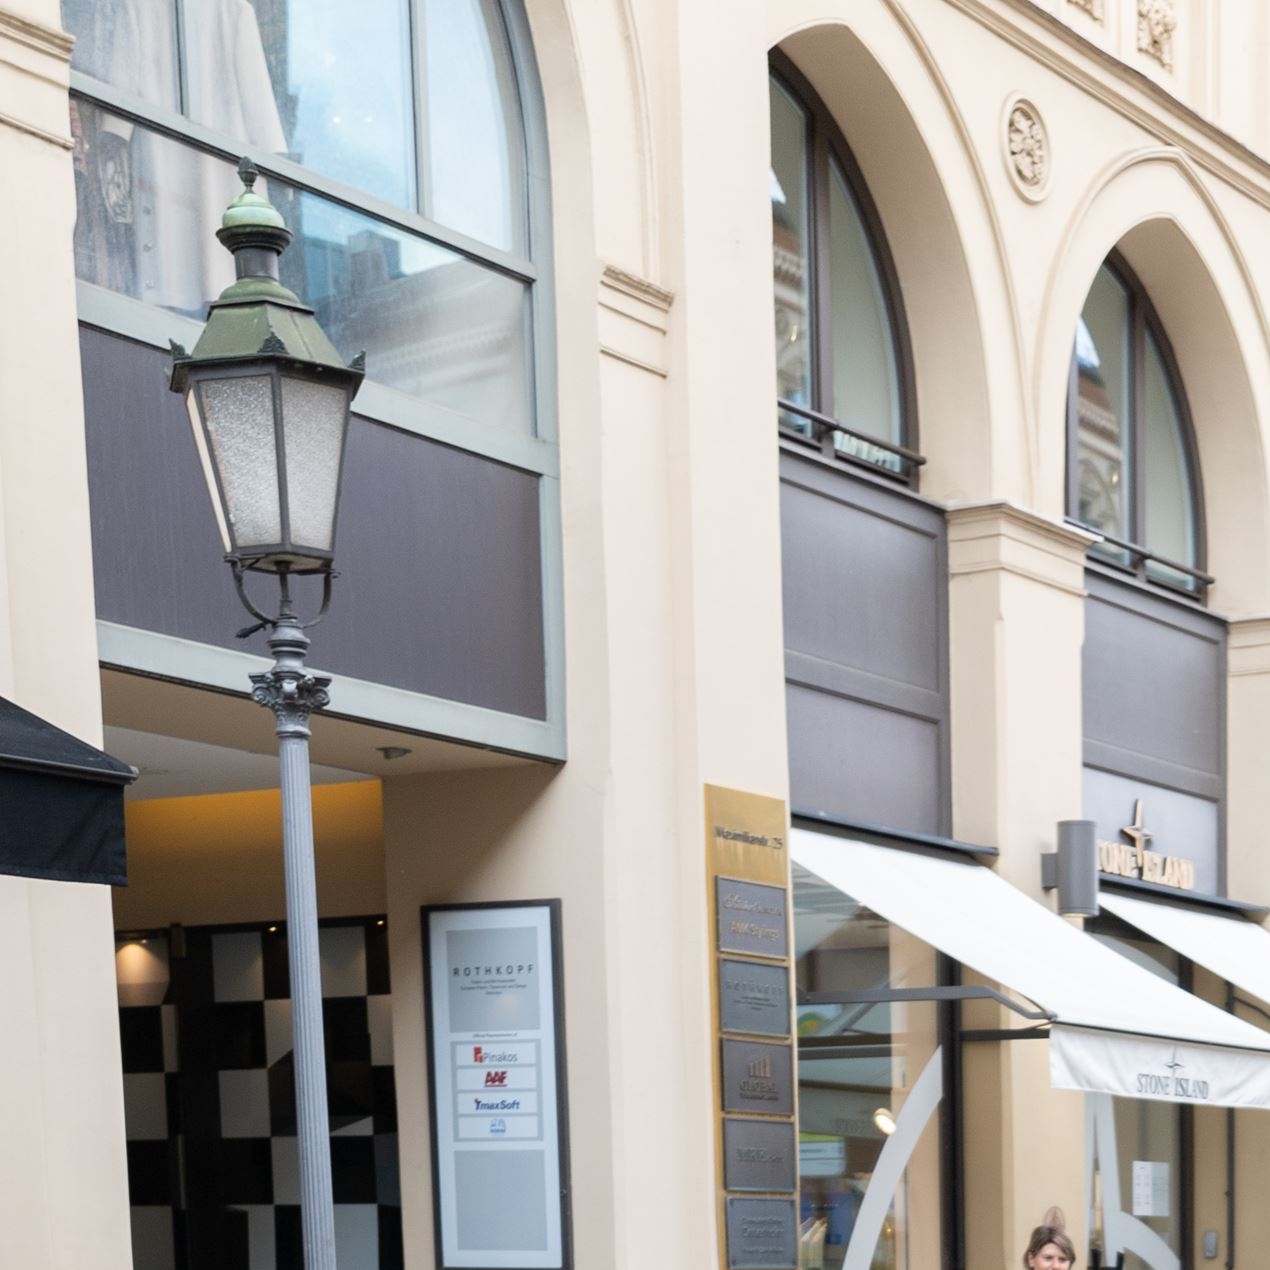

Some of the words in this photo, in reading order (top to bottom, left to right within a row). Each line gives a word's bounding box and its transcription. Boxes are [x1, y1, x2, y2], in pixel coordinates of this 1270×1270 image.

[1142, 848, 1195, 891] ISLAND
[452, 964, 534, 977] ROTHKOPF
[483, 1051, 518, 1063] Pinakos
[1137, 1073, 1171, 1096] STONE
[1174, 1077, 1209, 1100] ISLAND
[474, 1098, 520, 1110] TmaxSoft
